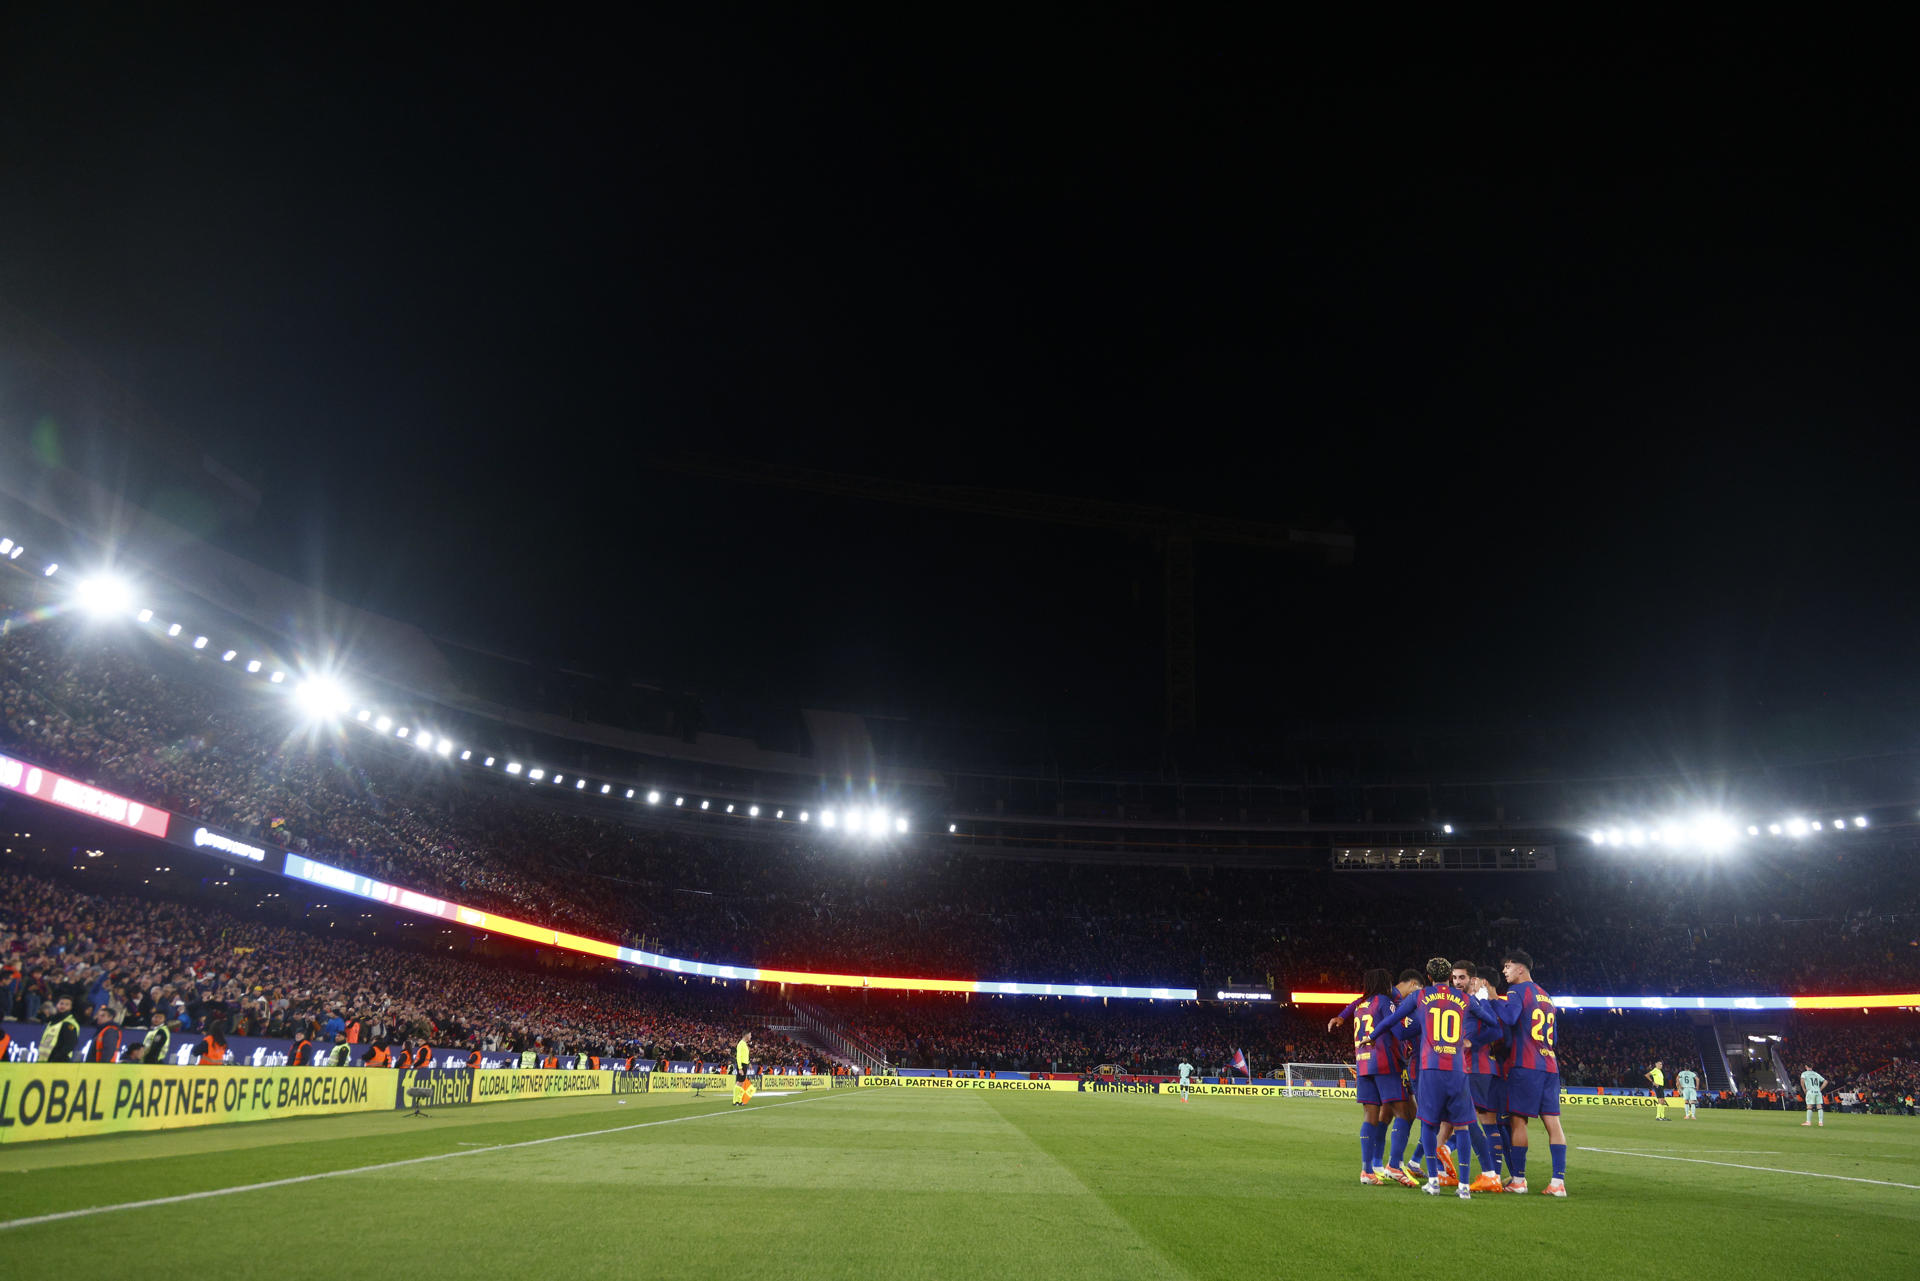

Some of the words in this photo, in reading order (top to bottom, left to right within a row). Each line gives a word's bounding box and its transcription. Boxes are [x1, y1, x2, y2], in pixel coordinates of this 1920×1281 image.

[1422, 993, 1445, 1005] LAMINE
[1446, 994, 1467, 1010] YAMAL
[1429, 1007, 1461, 1043] 10
[1531, 1008, 1555, 1046] 22
[479, 1075, 509, 1096] GLOBAL
[511, 1075, 542, 1094] PARTNER
[544, 1075, 554, 1092] OF
[554, 1075, 562, 1092] FC
[563, 1075, 600, 1092] BARCELONA
[863, 1077, 903, 1087] GLOBAL
[906, 1078, 953, 1088] PARTNER
[955, 1079, 969, 1088] OF
[972, 1080, 985, 1089] FC
[988, 1080, 1051, 1090] BARCELONA
[1684, 1075, 1690, 1084] 6
[1809, 1077, 1819, 1087] 14
[1096, 1082, 1155, 1094] whitebit
[1167, 1085, 1208, 1094] GLBAL
[1211, 1086, 1258, 1095] PARTNER
[1261, 1087, 1275, 1096] OF
[113, 1078, 219, 1119] PARTNER
[224, 1077, 248, 1112] OF
[252, 1077, 273, 1110] FC
[277, 1076, 368, 1108] BARCELONA
[1569, 1096, 1582, 1105] OF
[1587, 1097, 1600, 1105] FC
